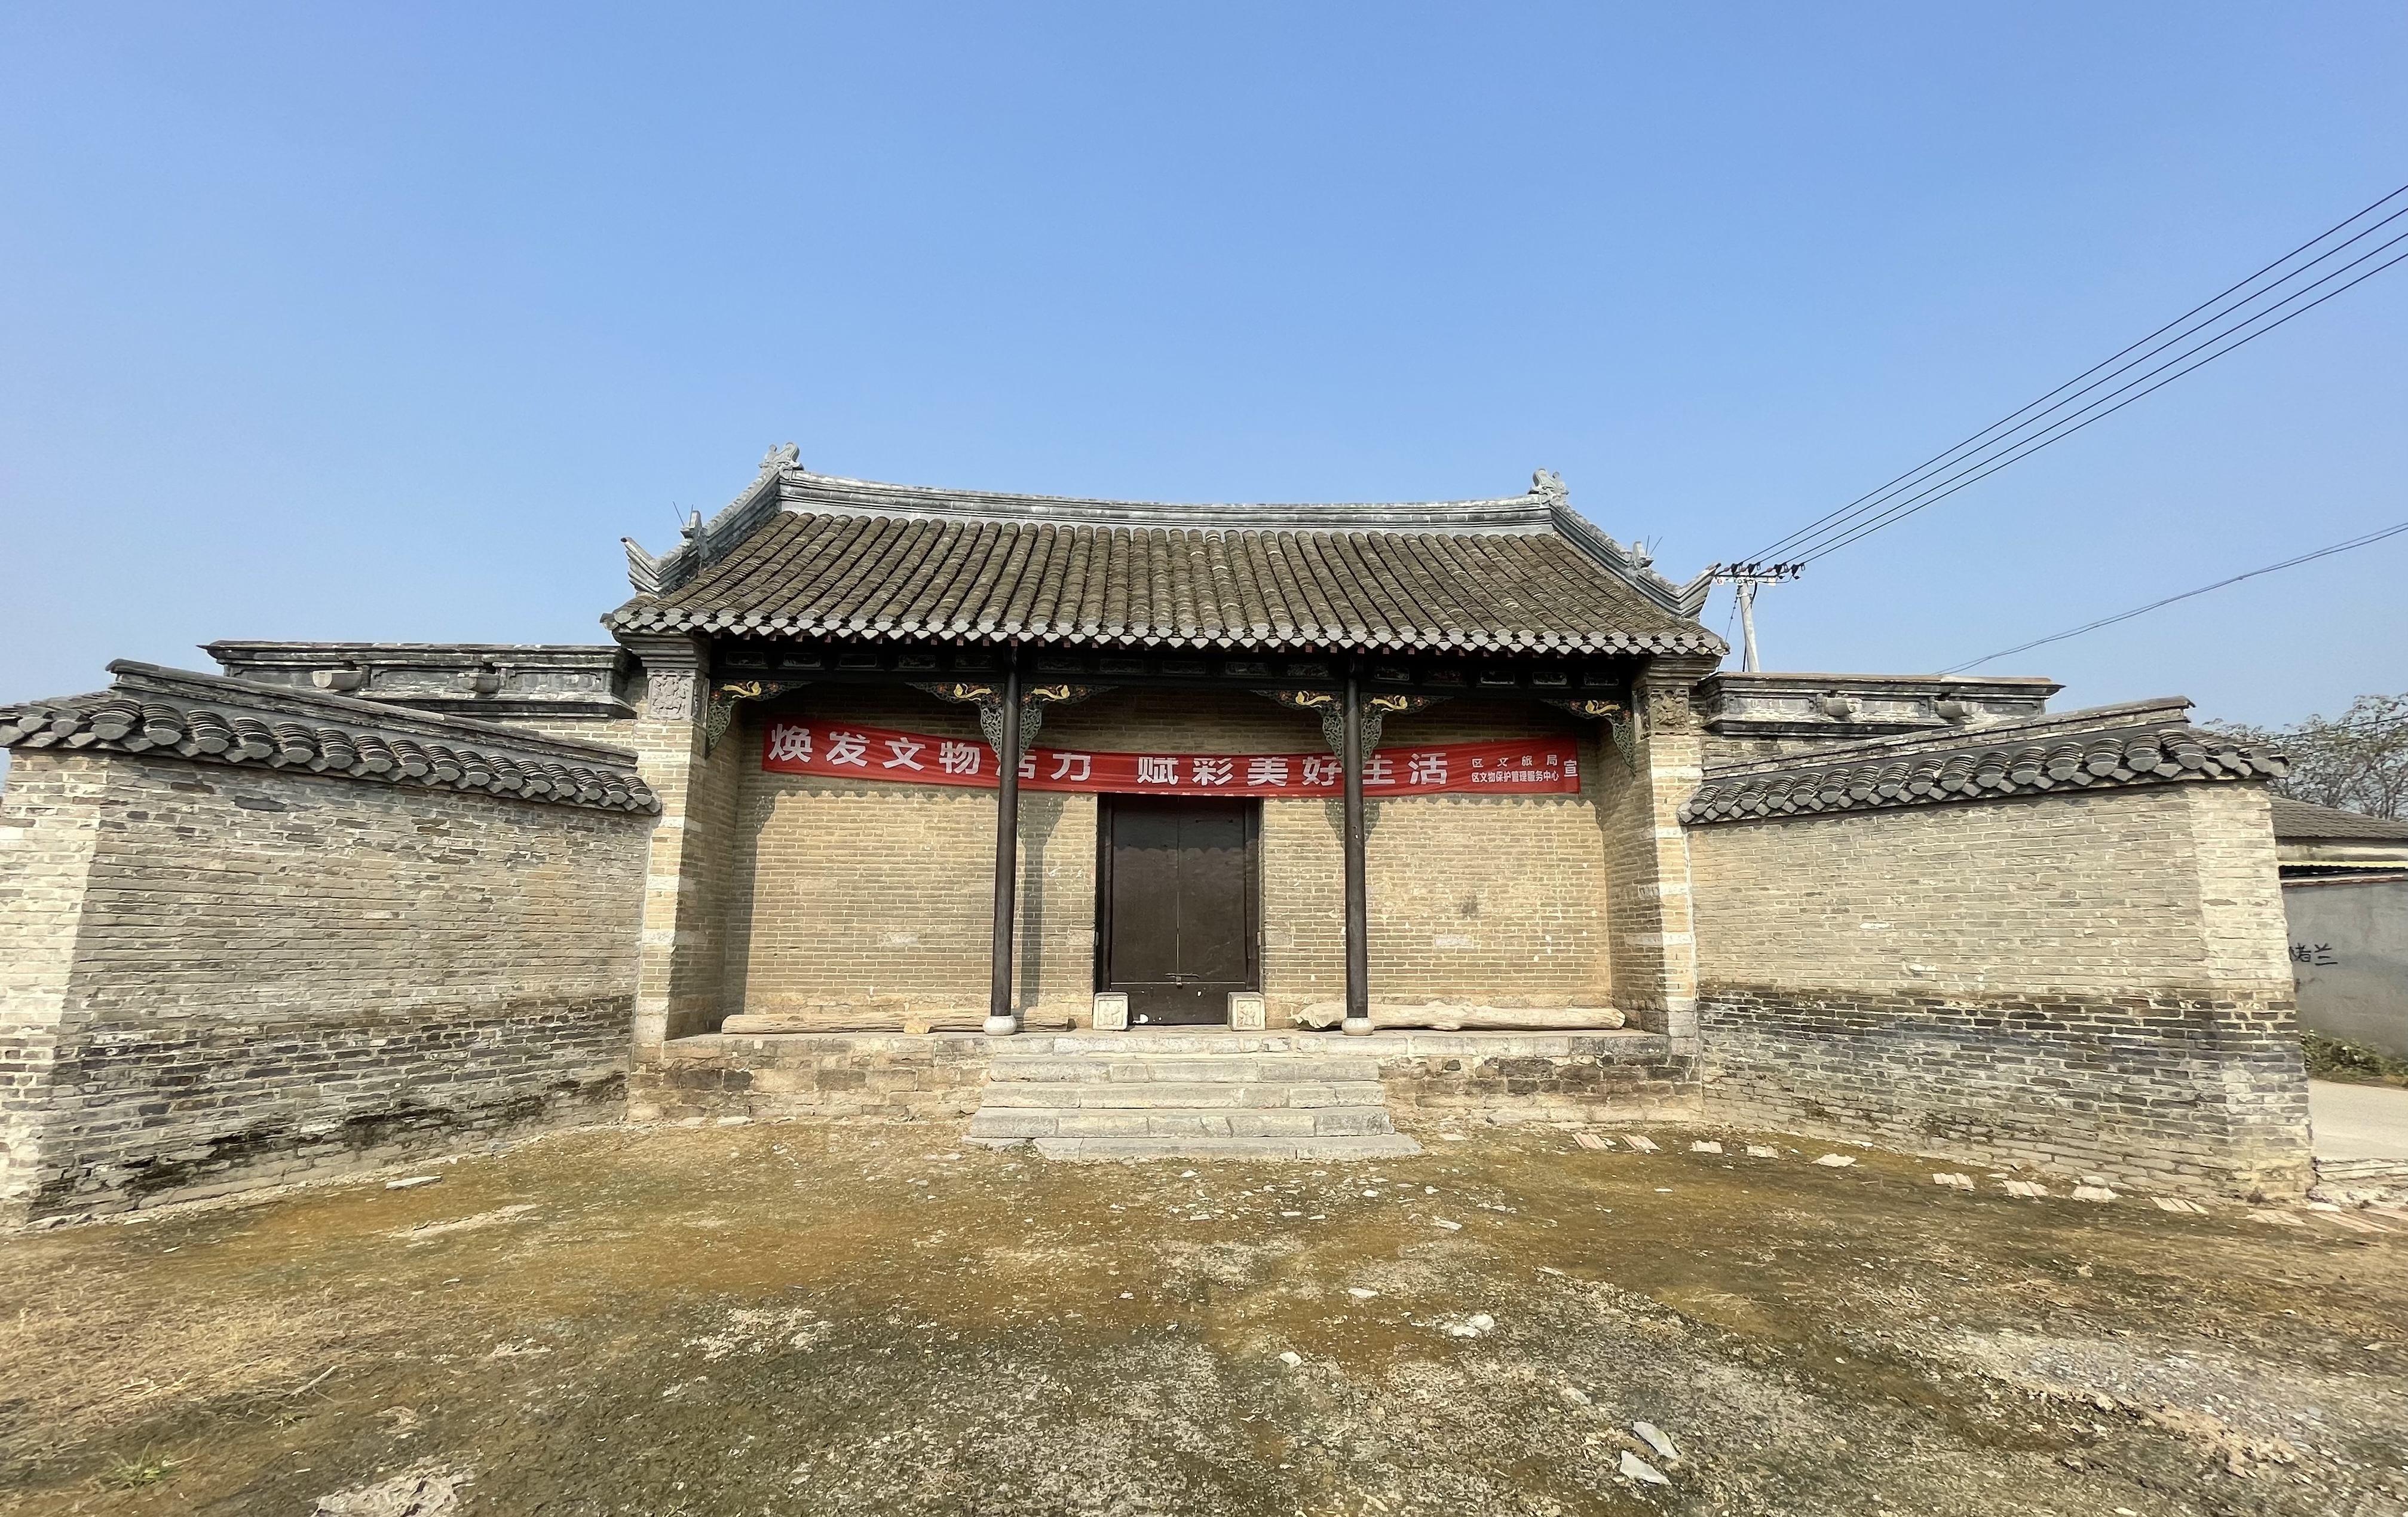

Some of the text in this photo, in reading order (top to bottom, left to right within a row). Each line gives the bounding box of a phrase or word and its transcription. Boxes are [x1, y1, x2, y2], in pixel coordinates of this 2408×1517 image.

[1472, 754, 1558, 768] 区文旅局
[1564, 759, 1578, 777] 宣
[1138, 753, 1447, 786] 赋彩美好生活
[1471, 770, 1560, 783] 区文物保护管理服务中心
